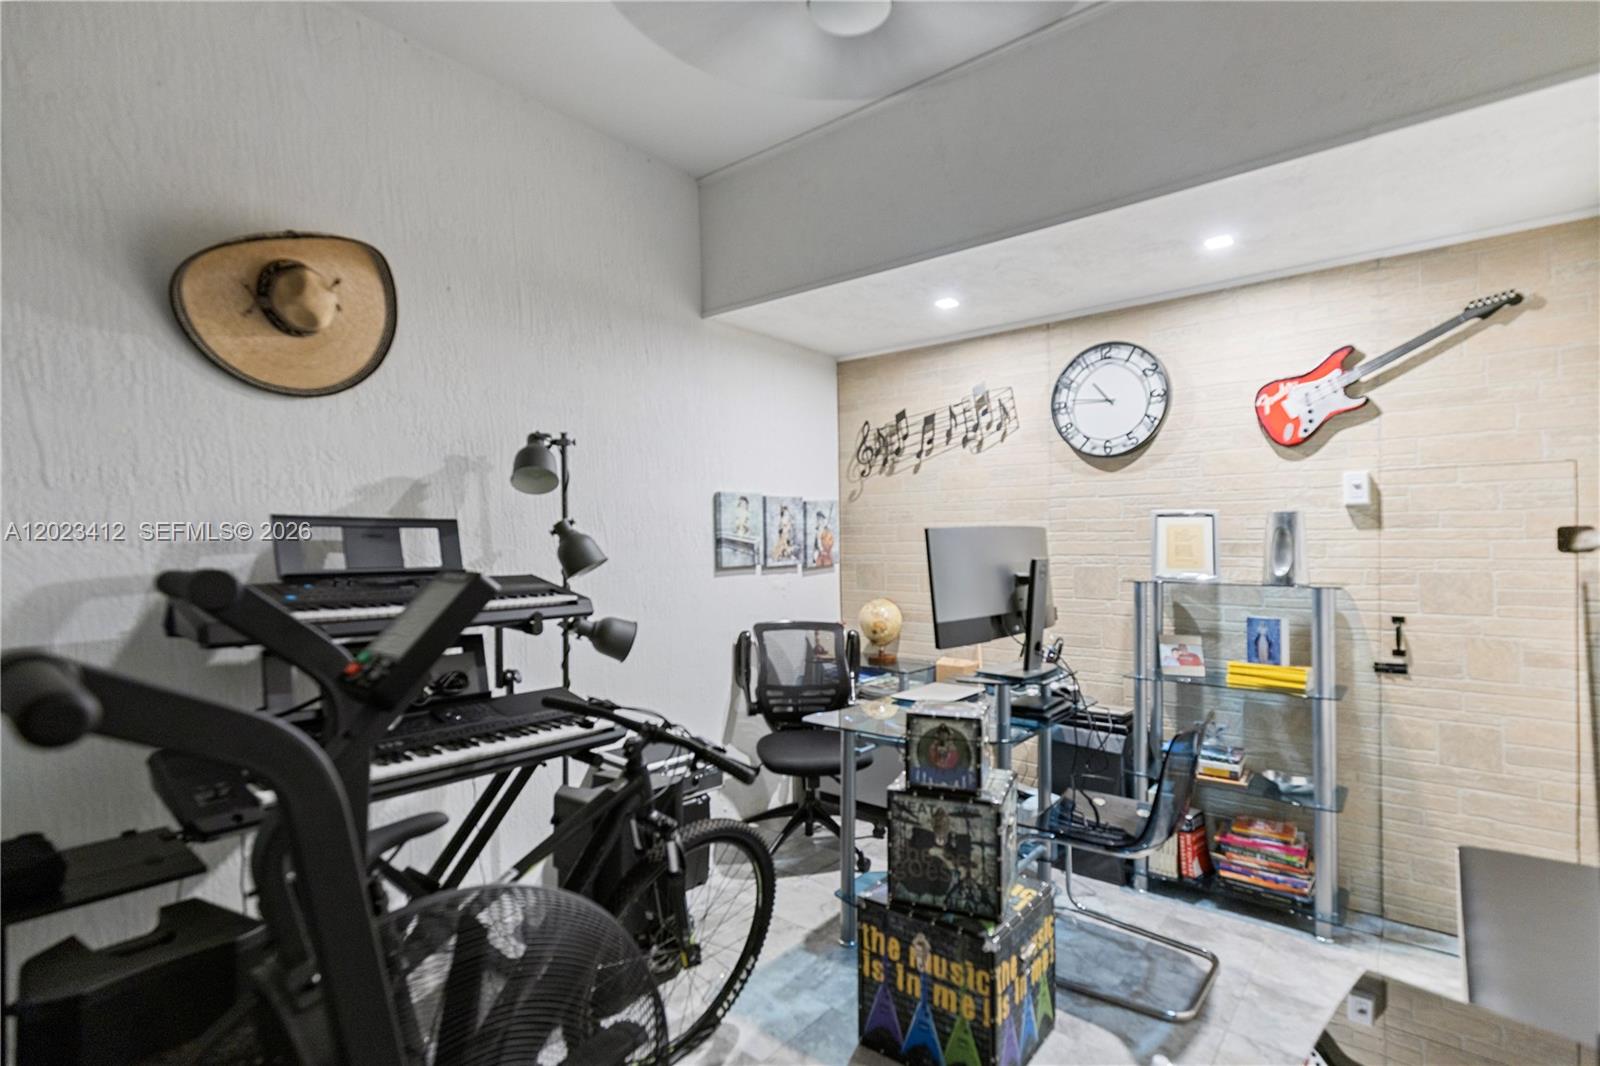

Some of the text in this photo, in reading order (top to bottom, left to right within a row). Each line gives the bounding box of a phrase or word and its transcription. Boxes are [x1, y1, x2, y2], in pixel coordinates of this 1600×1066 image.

[1100, 345, 1113, 360] 12
[1142, 363, 1160, 377] 2
[1061, 423, 1073, 433] 8
[1080, 434, 1090, 450] 7
[1126, 431, 1139, 446] 5
[1103, 440, 1113, 455] 6
[860, 922, 901, 961] the
[862, 951, 886, 983] is
[896, 963, 922, 999] in
